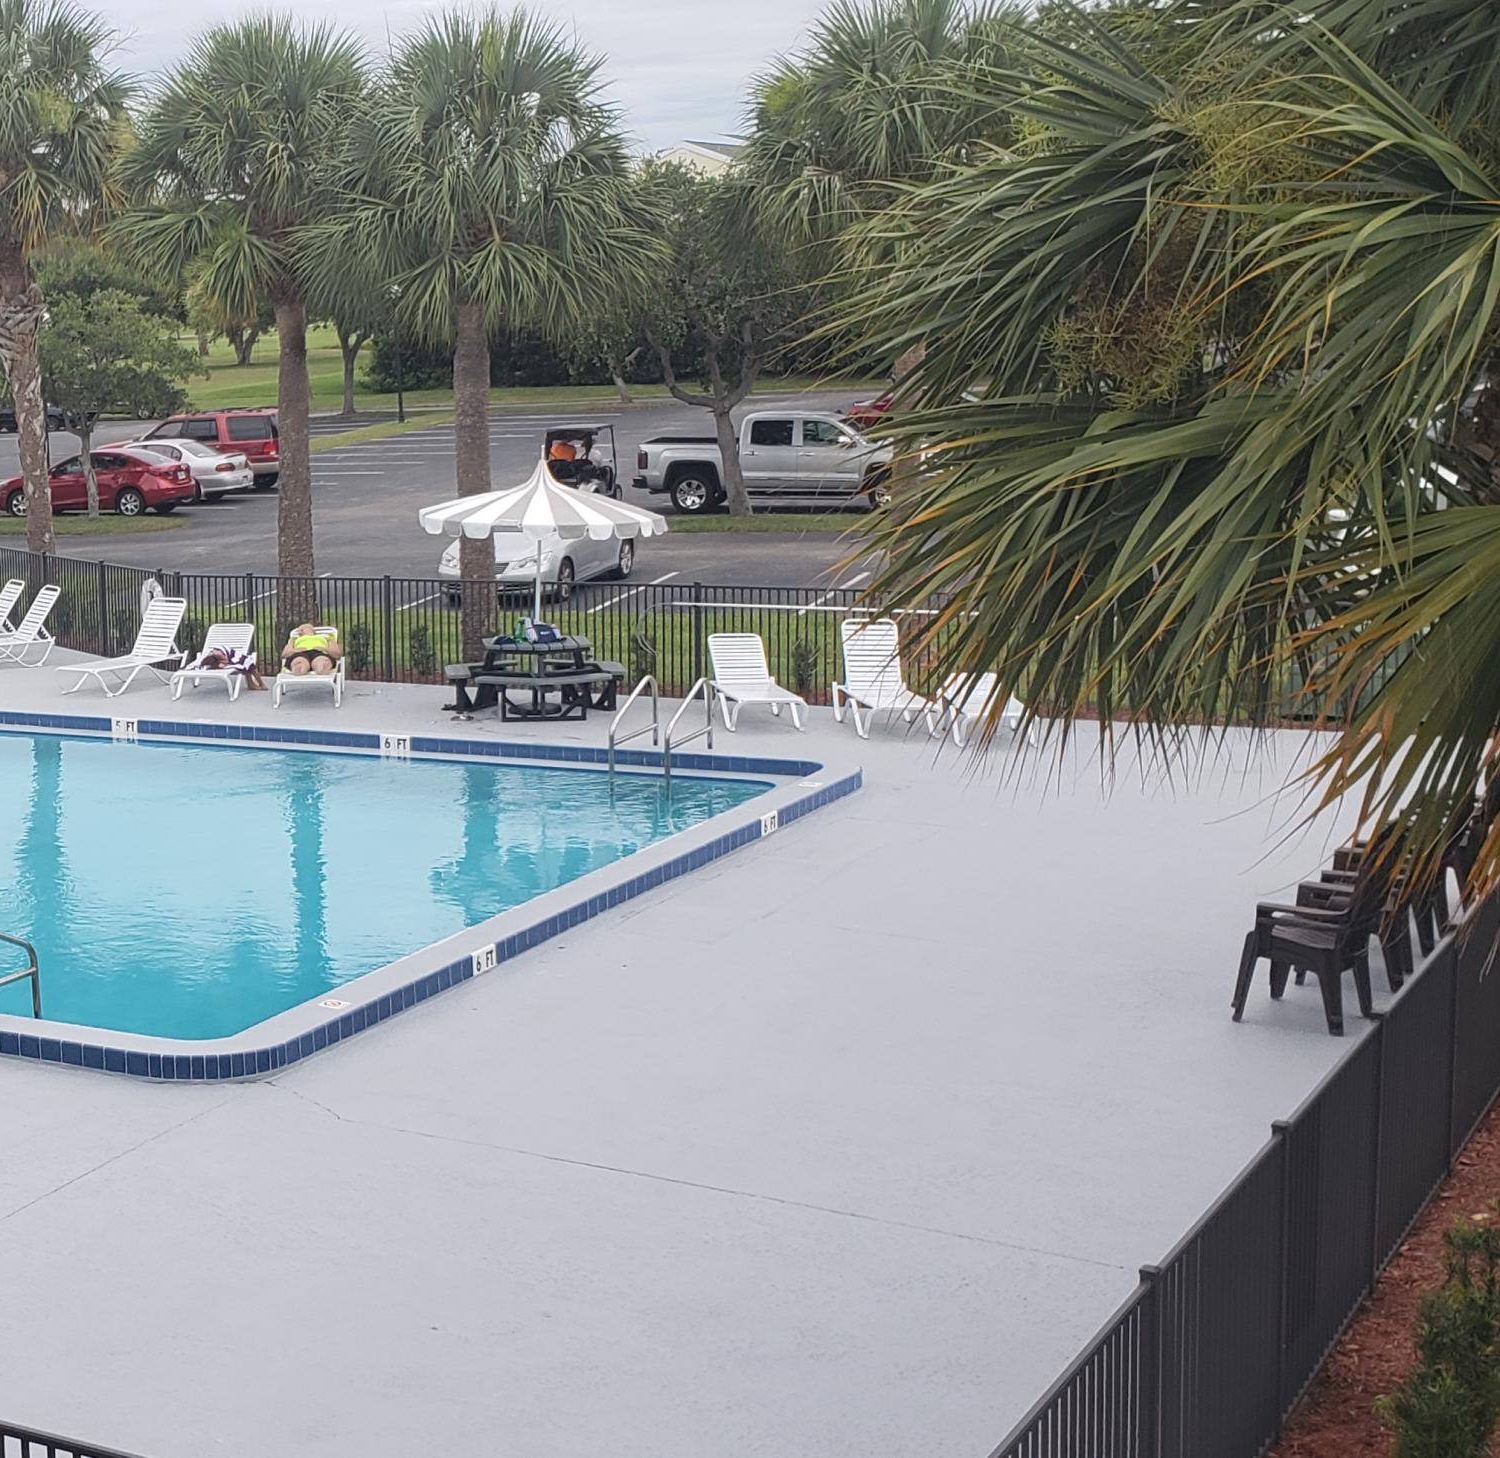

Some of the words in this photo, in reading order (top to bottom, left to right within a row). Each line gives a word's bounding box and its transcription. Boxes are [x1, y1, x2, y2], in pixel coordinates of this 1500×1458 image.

[126, 721, 135, 732] FT
[385, 737, 391, 748] 6
[397, 738, 407, 749] FT
[763, 821, 768, 833] 6
[769, 815, 776, 830] FT
[476, 957, 481, 972] 6
[485, 950, 494, 968] FT
